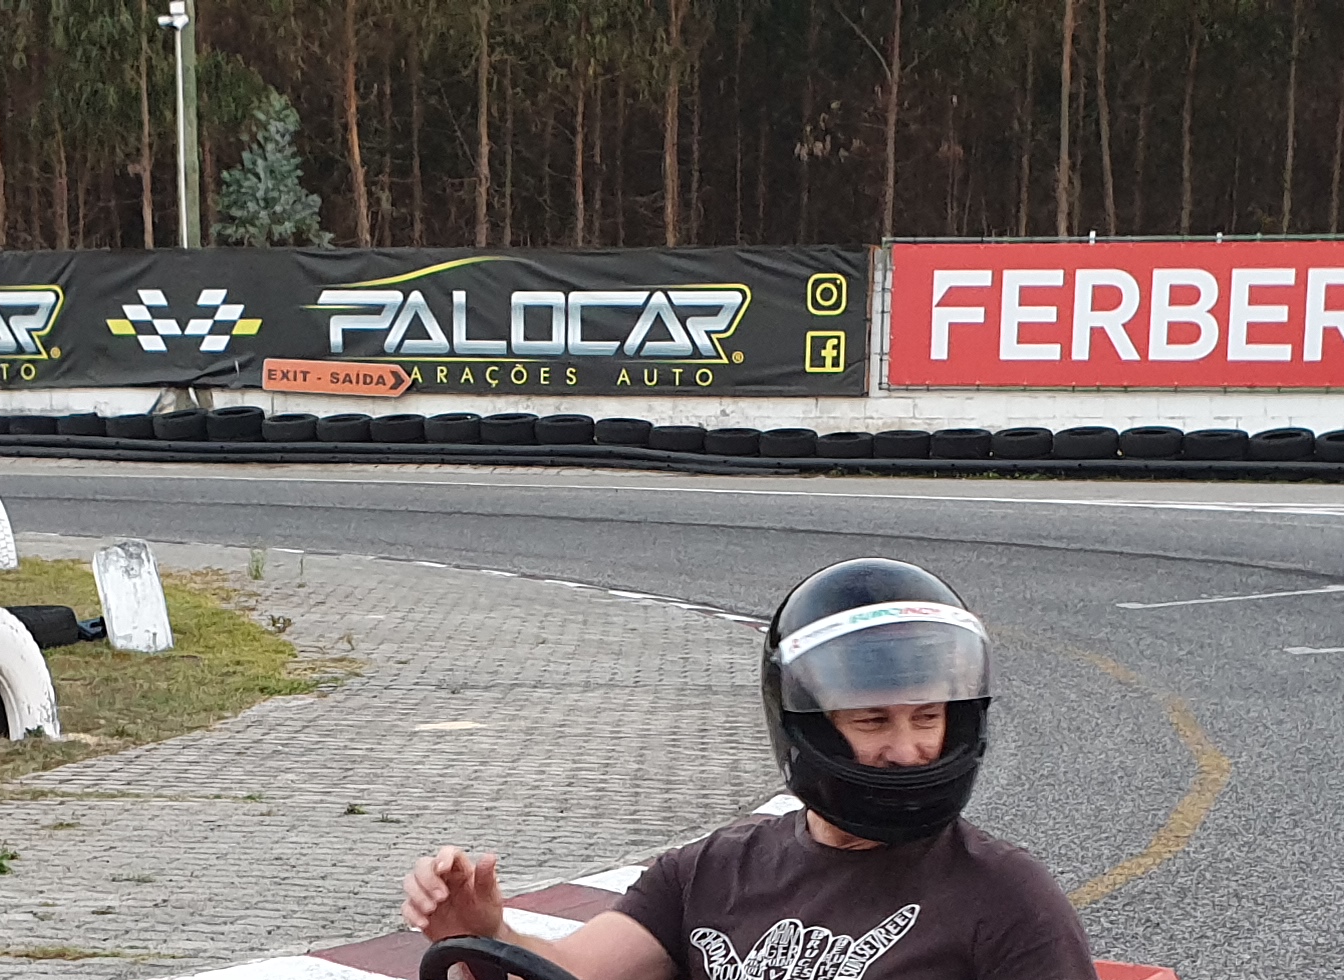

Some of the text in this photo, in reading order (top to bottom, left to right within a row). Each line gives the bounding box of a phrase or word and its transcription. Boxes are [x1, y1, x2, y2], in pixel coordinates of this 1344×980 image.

[316, 289, 744, 357] PALOCAR
[267, 368, 311, 383] EXIT
[410, 363, 715, 388] ARAÇÕES AUTO
